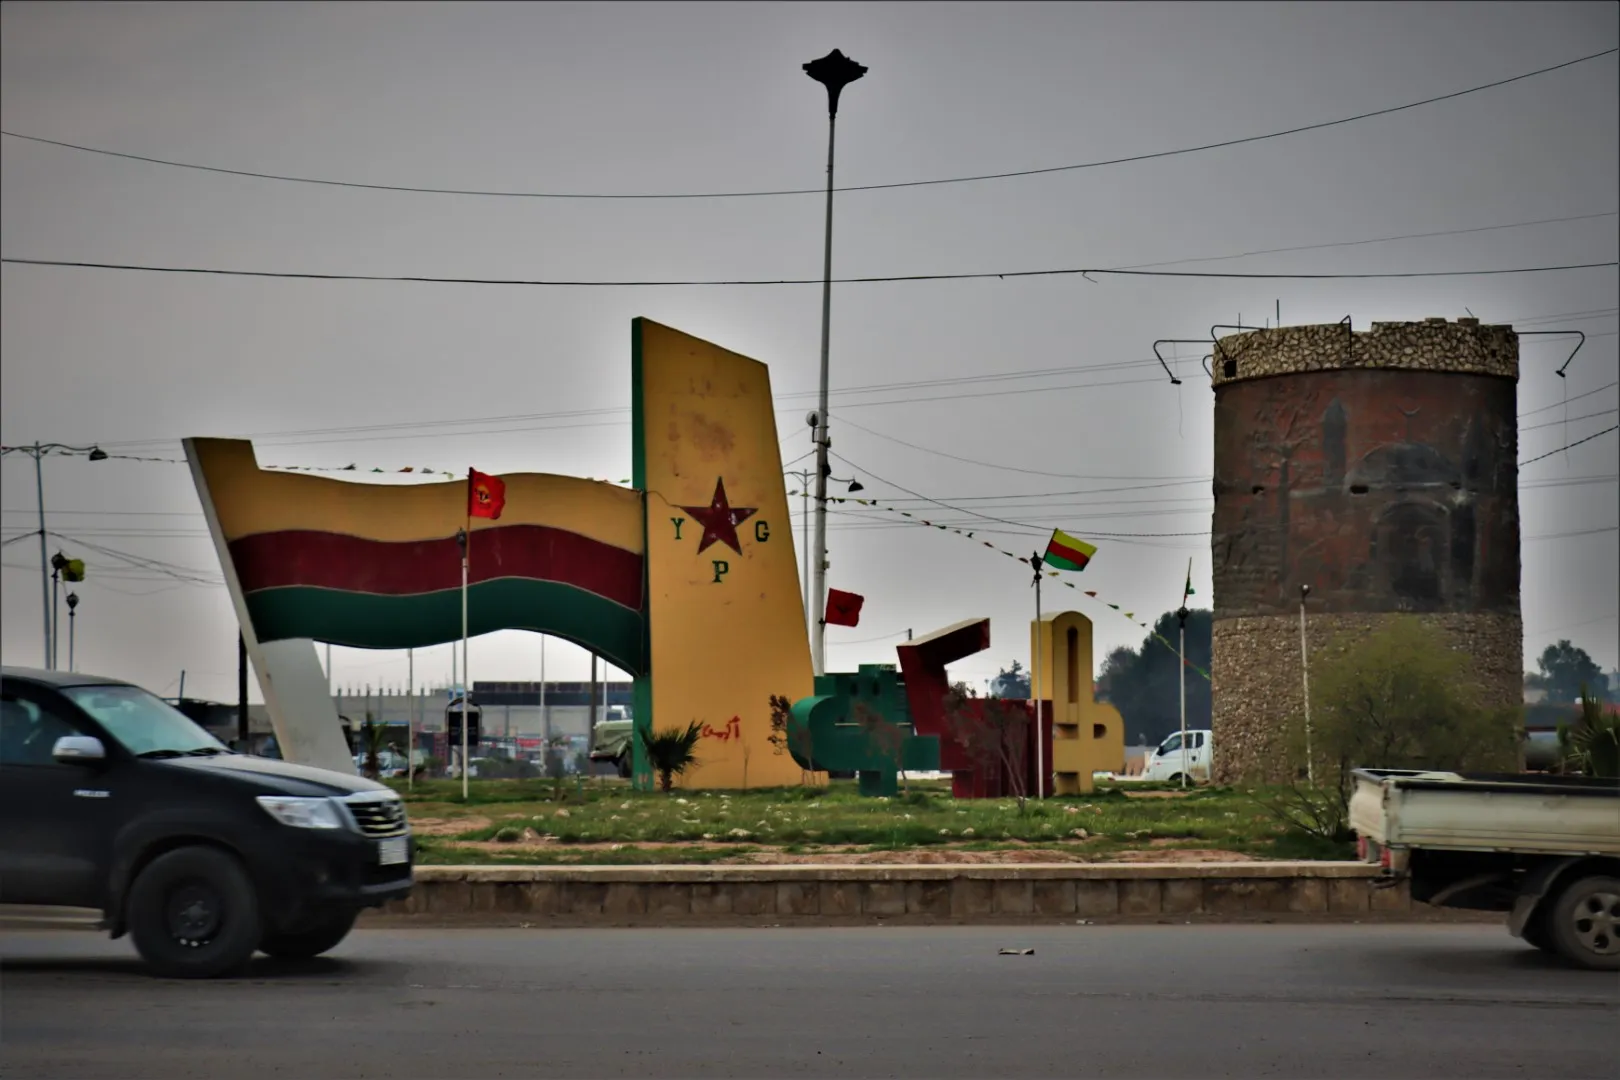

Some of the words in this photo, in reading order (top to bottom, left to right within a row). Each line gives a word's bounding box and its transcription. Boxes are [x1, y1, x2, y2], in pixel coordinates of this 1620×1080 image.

[671, 518, 685, 540] Y
[755, 520, 770, 542] G
[712, 560, 729, 583] P
